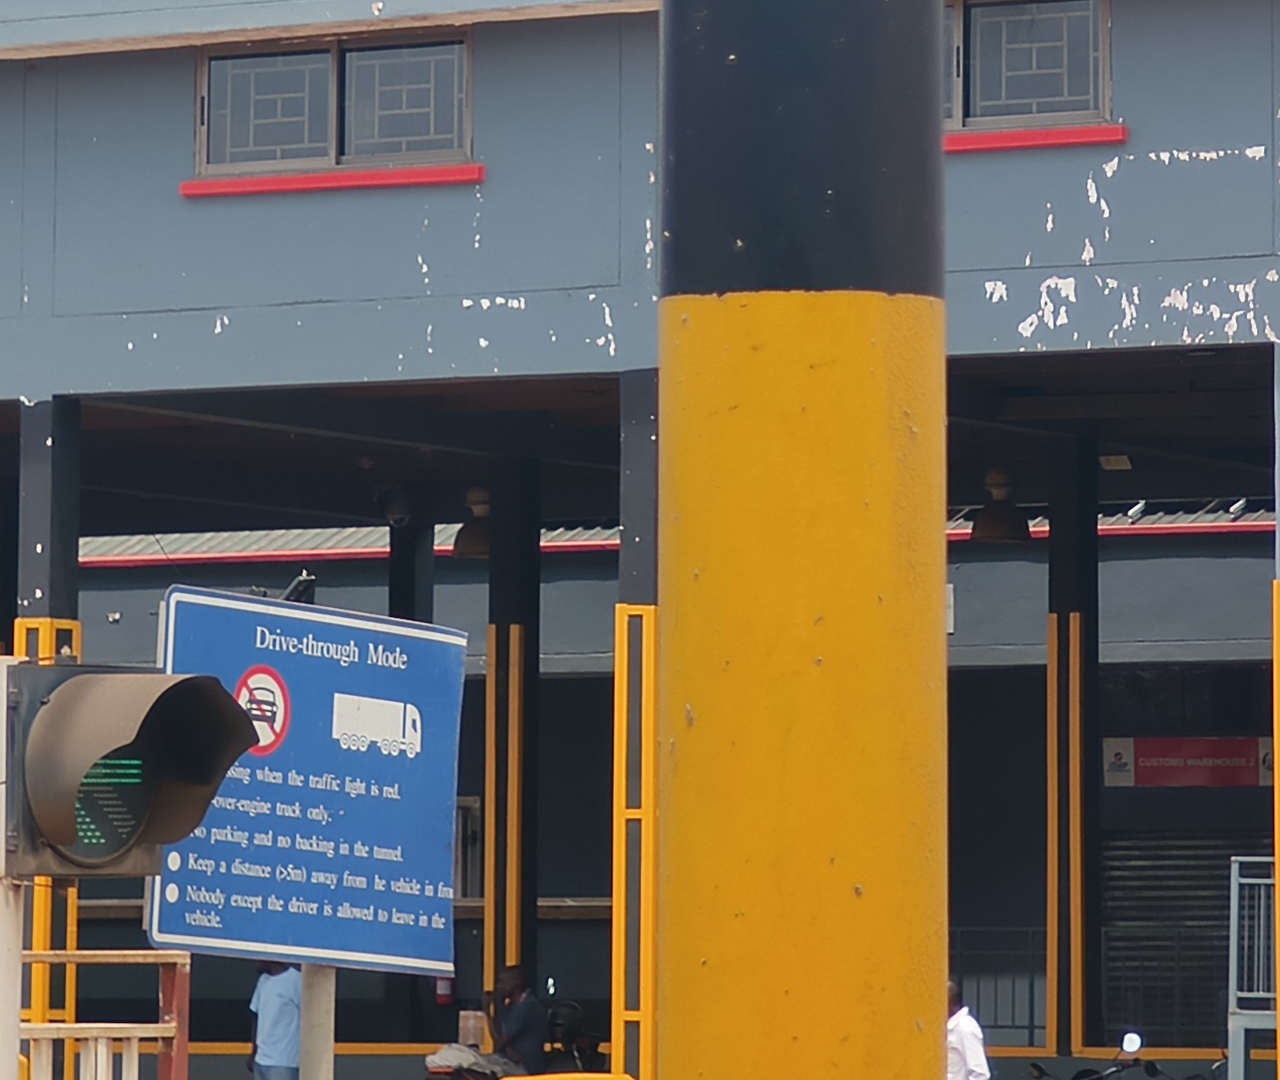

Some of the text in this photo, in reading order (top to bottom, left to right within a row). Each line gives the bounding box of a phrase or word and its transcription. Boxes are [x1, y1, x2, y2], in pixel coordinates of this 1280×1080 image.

[255, 626, 408, 670] Drive-through Mode
[256, 766, 283, 784] when
[288, 769, 304, 787] the
[309, 773, 341, 792] traffic
[345, 776, 366, 798] light
[370, 780, 379, 796] is
[383, 783, 401, 799] red.
[276, 802, 302, 818] truck
[307, 804, 332, 826] only.
[211, 825, 249, 848] parking
[253, 830, 273, 846] and
[277, 836, 291, 848] no
[295, 833, 335, 858] backing
[339, 838, 350, 855] in
[354, 841, 370, 858] the
[373, 845, 404, 862] tunnel.
[188, 852, 216, 876] Keep
[219, 861, 227, 874] a
[231, 858, 272, 878] distance
[275, 863, 307, 883] (>5m)
[310, 871, 338, 890] away
[343, 870, 368, 889] from
[390, 877, 422, 895] vehicle
[425, 880, 434, 897] in
[185, 909, 223, 928] vehicle.
[186, 885, 446, 929] Nobody except the driver is allowed to leave in the
